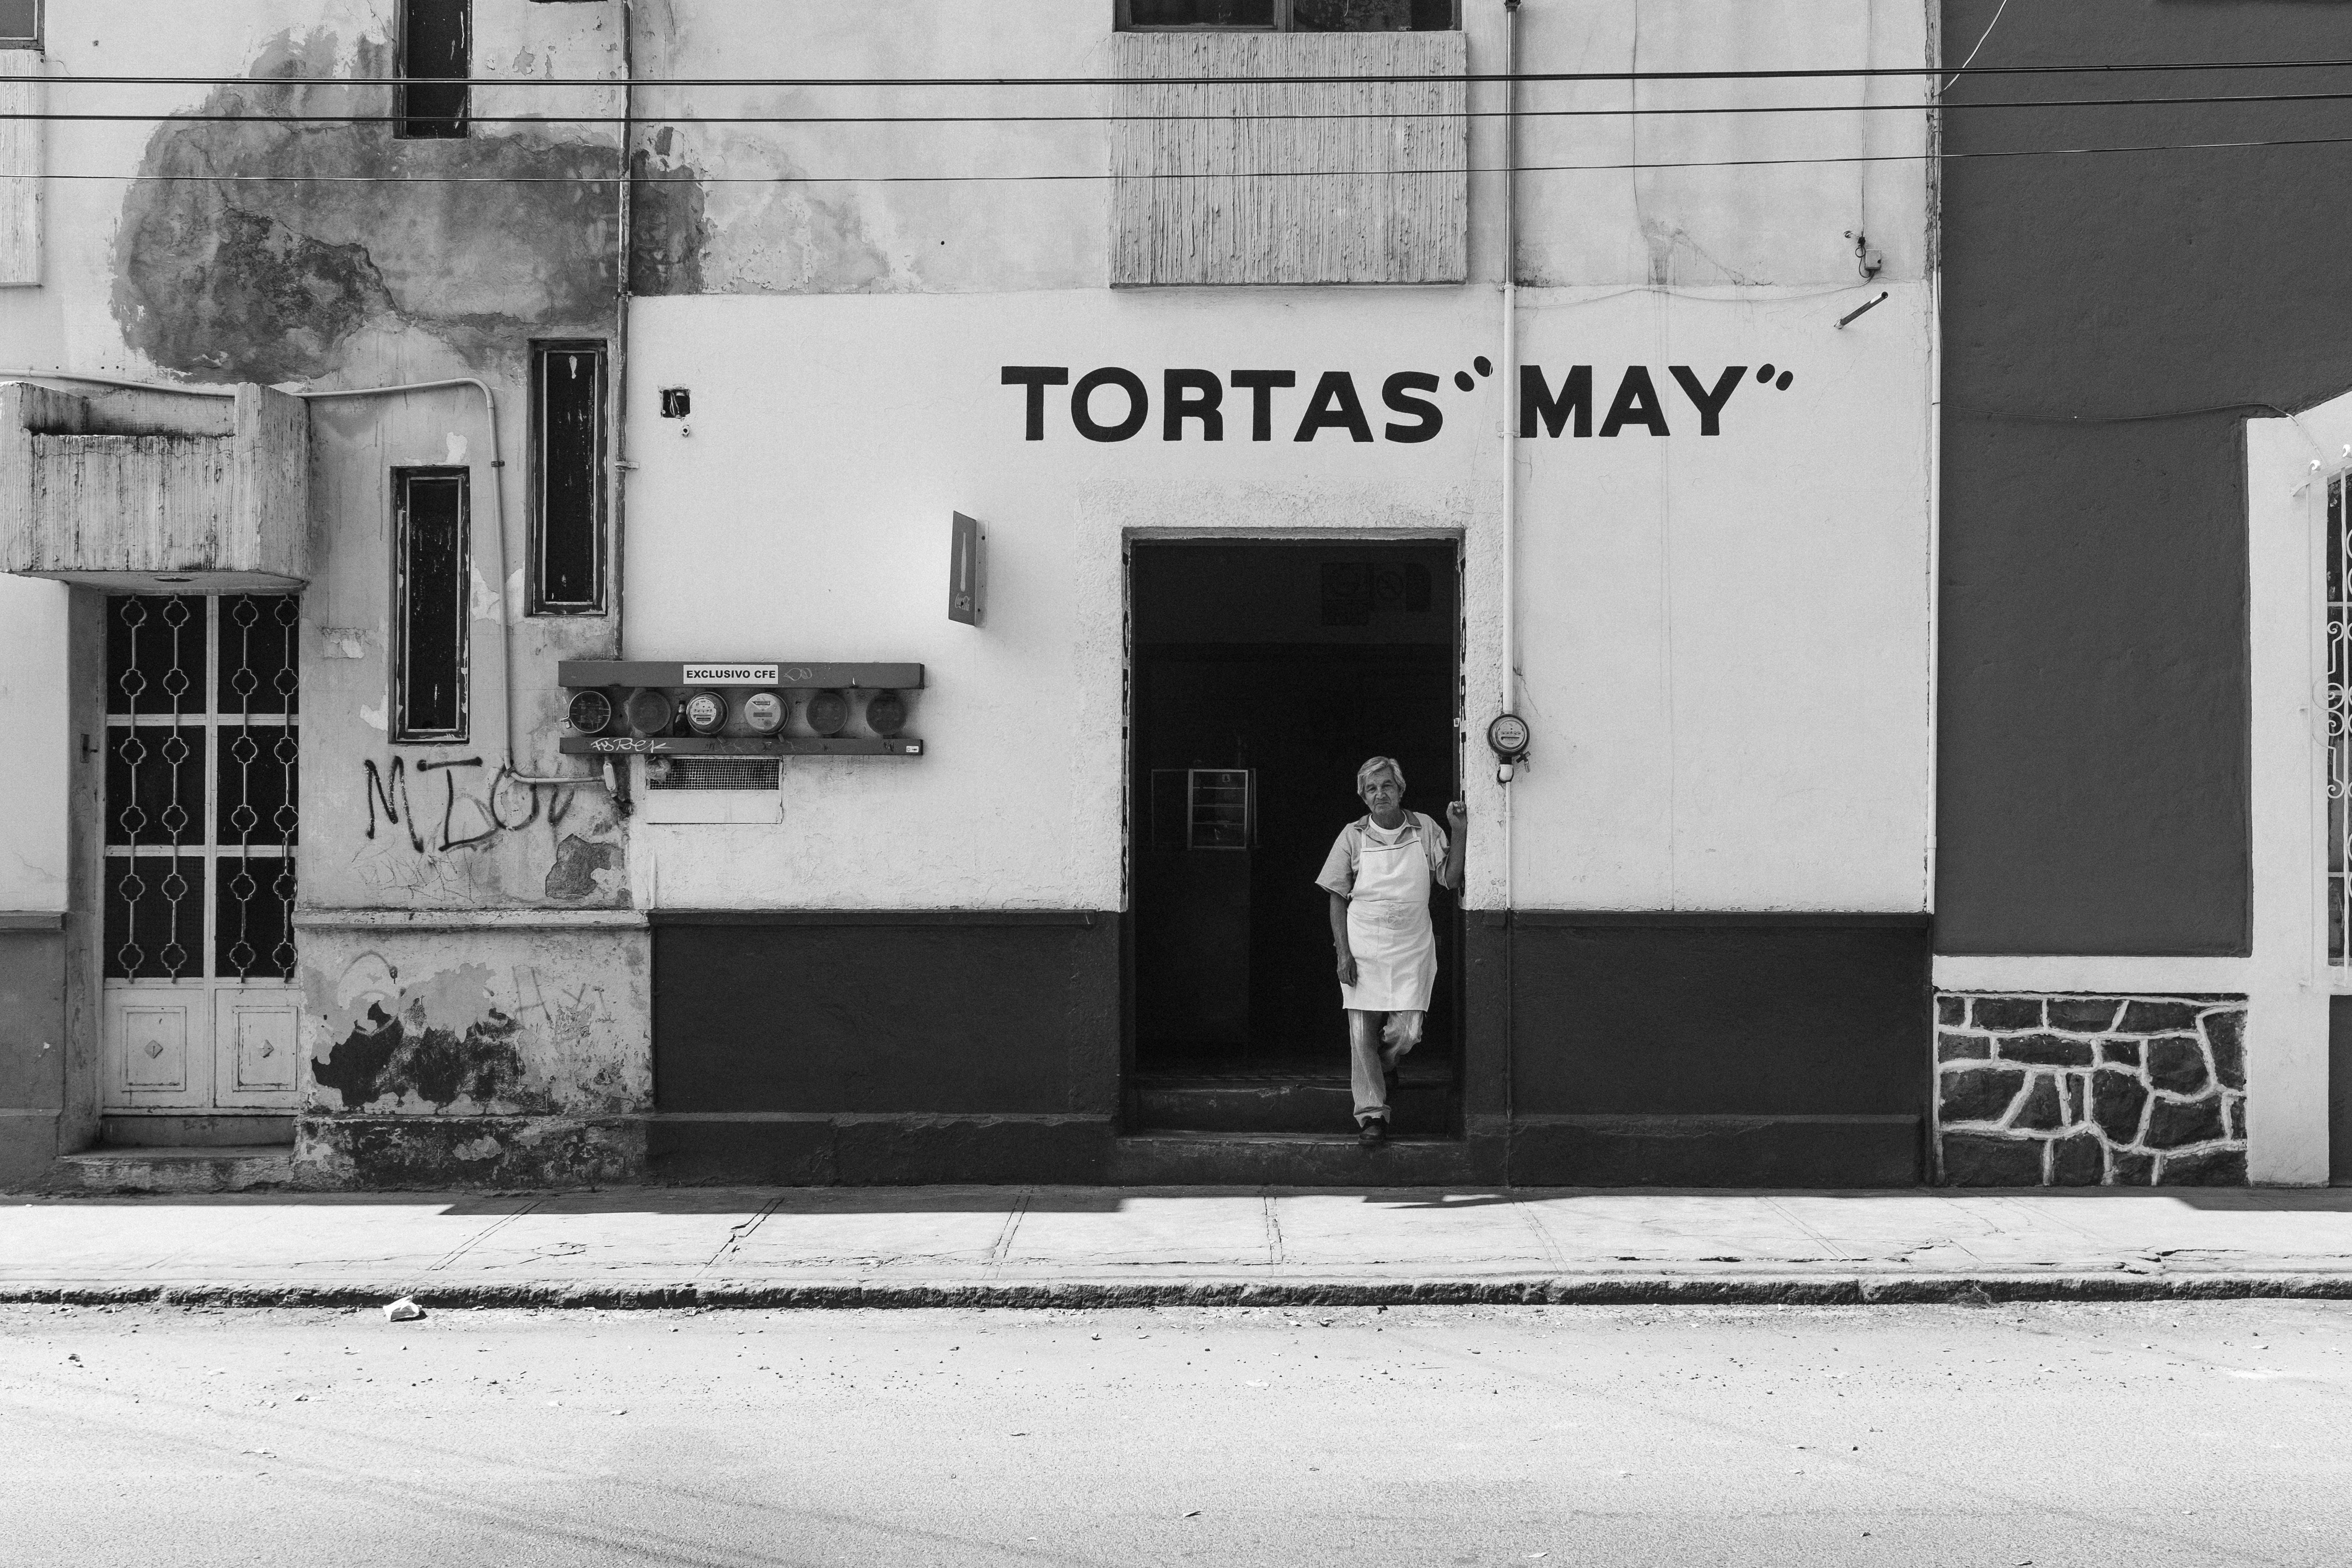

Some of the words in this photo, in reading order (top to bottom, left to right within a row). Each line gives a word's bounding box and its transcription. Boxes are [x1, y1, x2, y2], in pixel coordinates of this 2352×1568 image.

[1001, 366, 1443, 443] TORTAS
[687, 670, 750, 678] EXCLUSIVO
[754, 670, 776, 678] CFE
